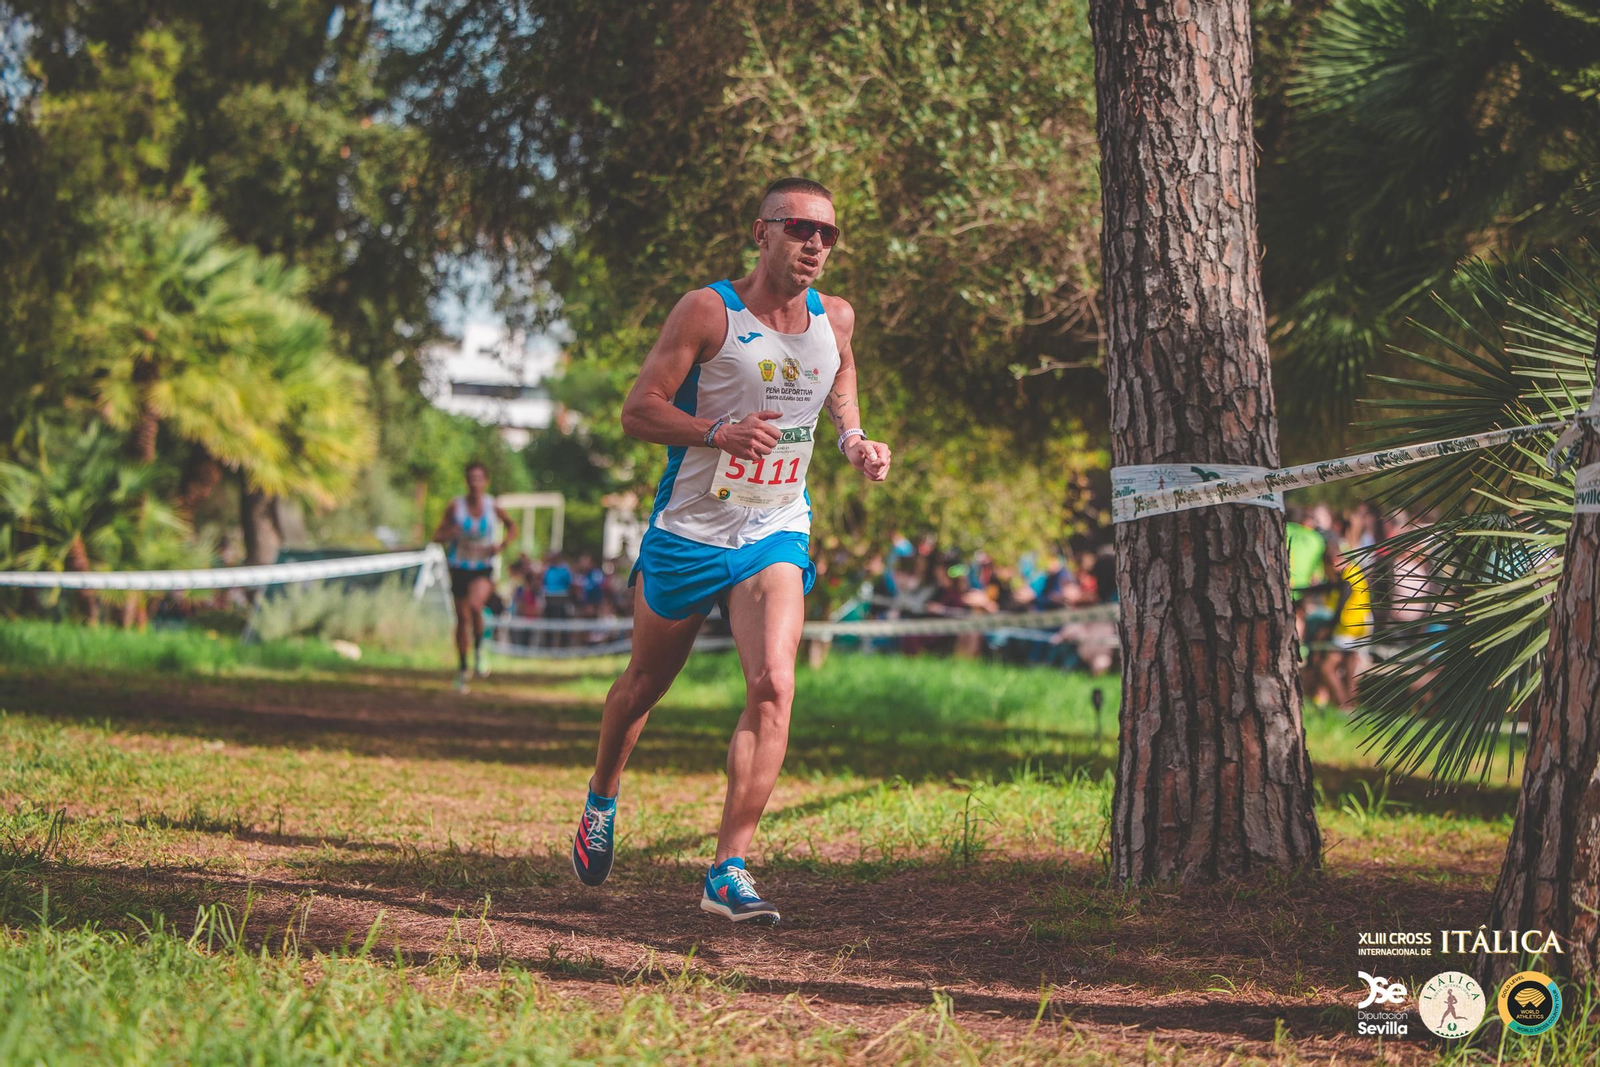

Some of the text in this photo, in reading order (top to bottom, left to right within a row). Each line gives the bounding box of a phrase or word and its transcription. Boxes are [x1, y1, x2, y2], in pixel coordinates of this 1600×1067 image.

[766, 386, 813, 395] PEÑA DEPORTIVA
[725, 455, 800, 485] 5111
